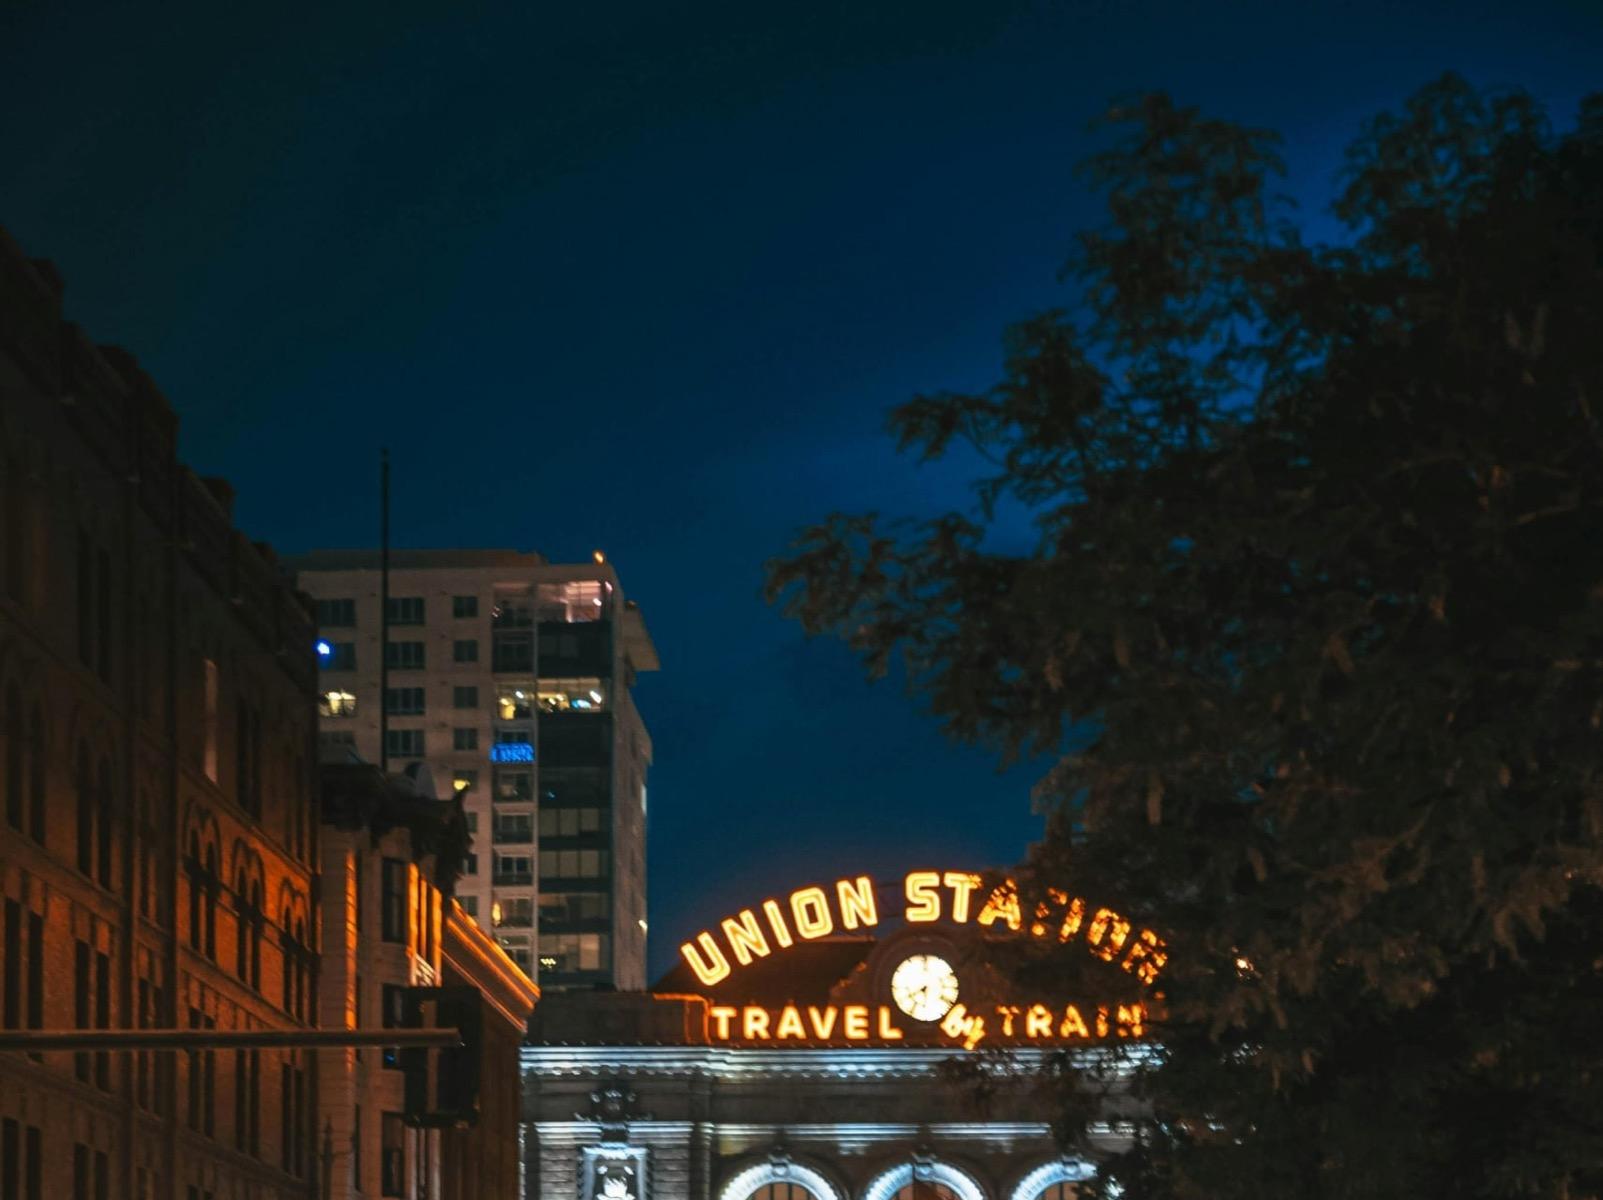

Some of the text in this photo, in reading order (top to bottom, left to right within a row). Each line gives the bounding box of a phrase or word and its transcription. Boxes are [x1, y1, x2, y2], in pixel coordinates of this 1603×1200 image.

[681, 876, 878, 986] UNION
[711, 1006, 903, 1039] TRAVEL
[997, 1004, 1149, 1037] TRAIN
